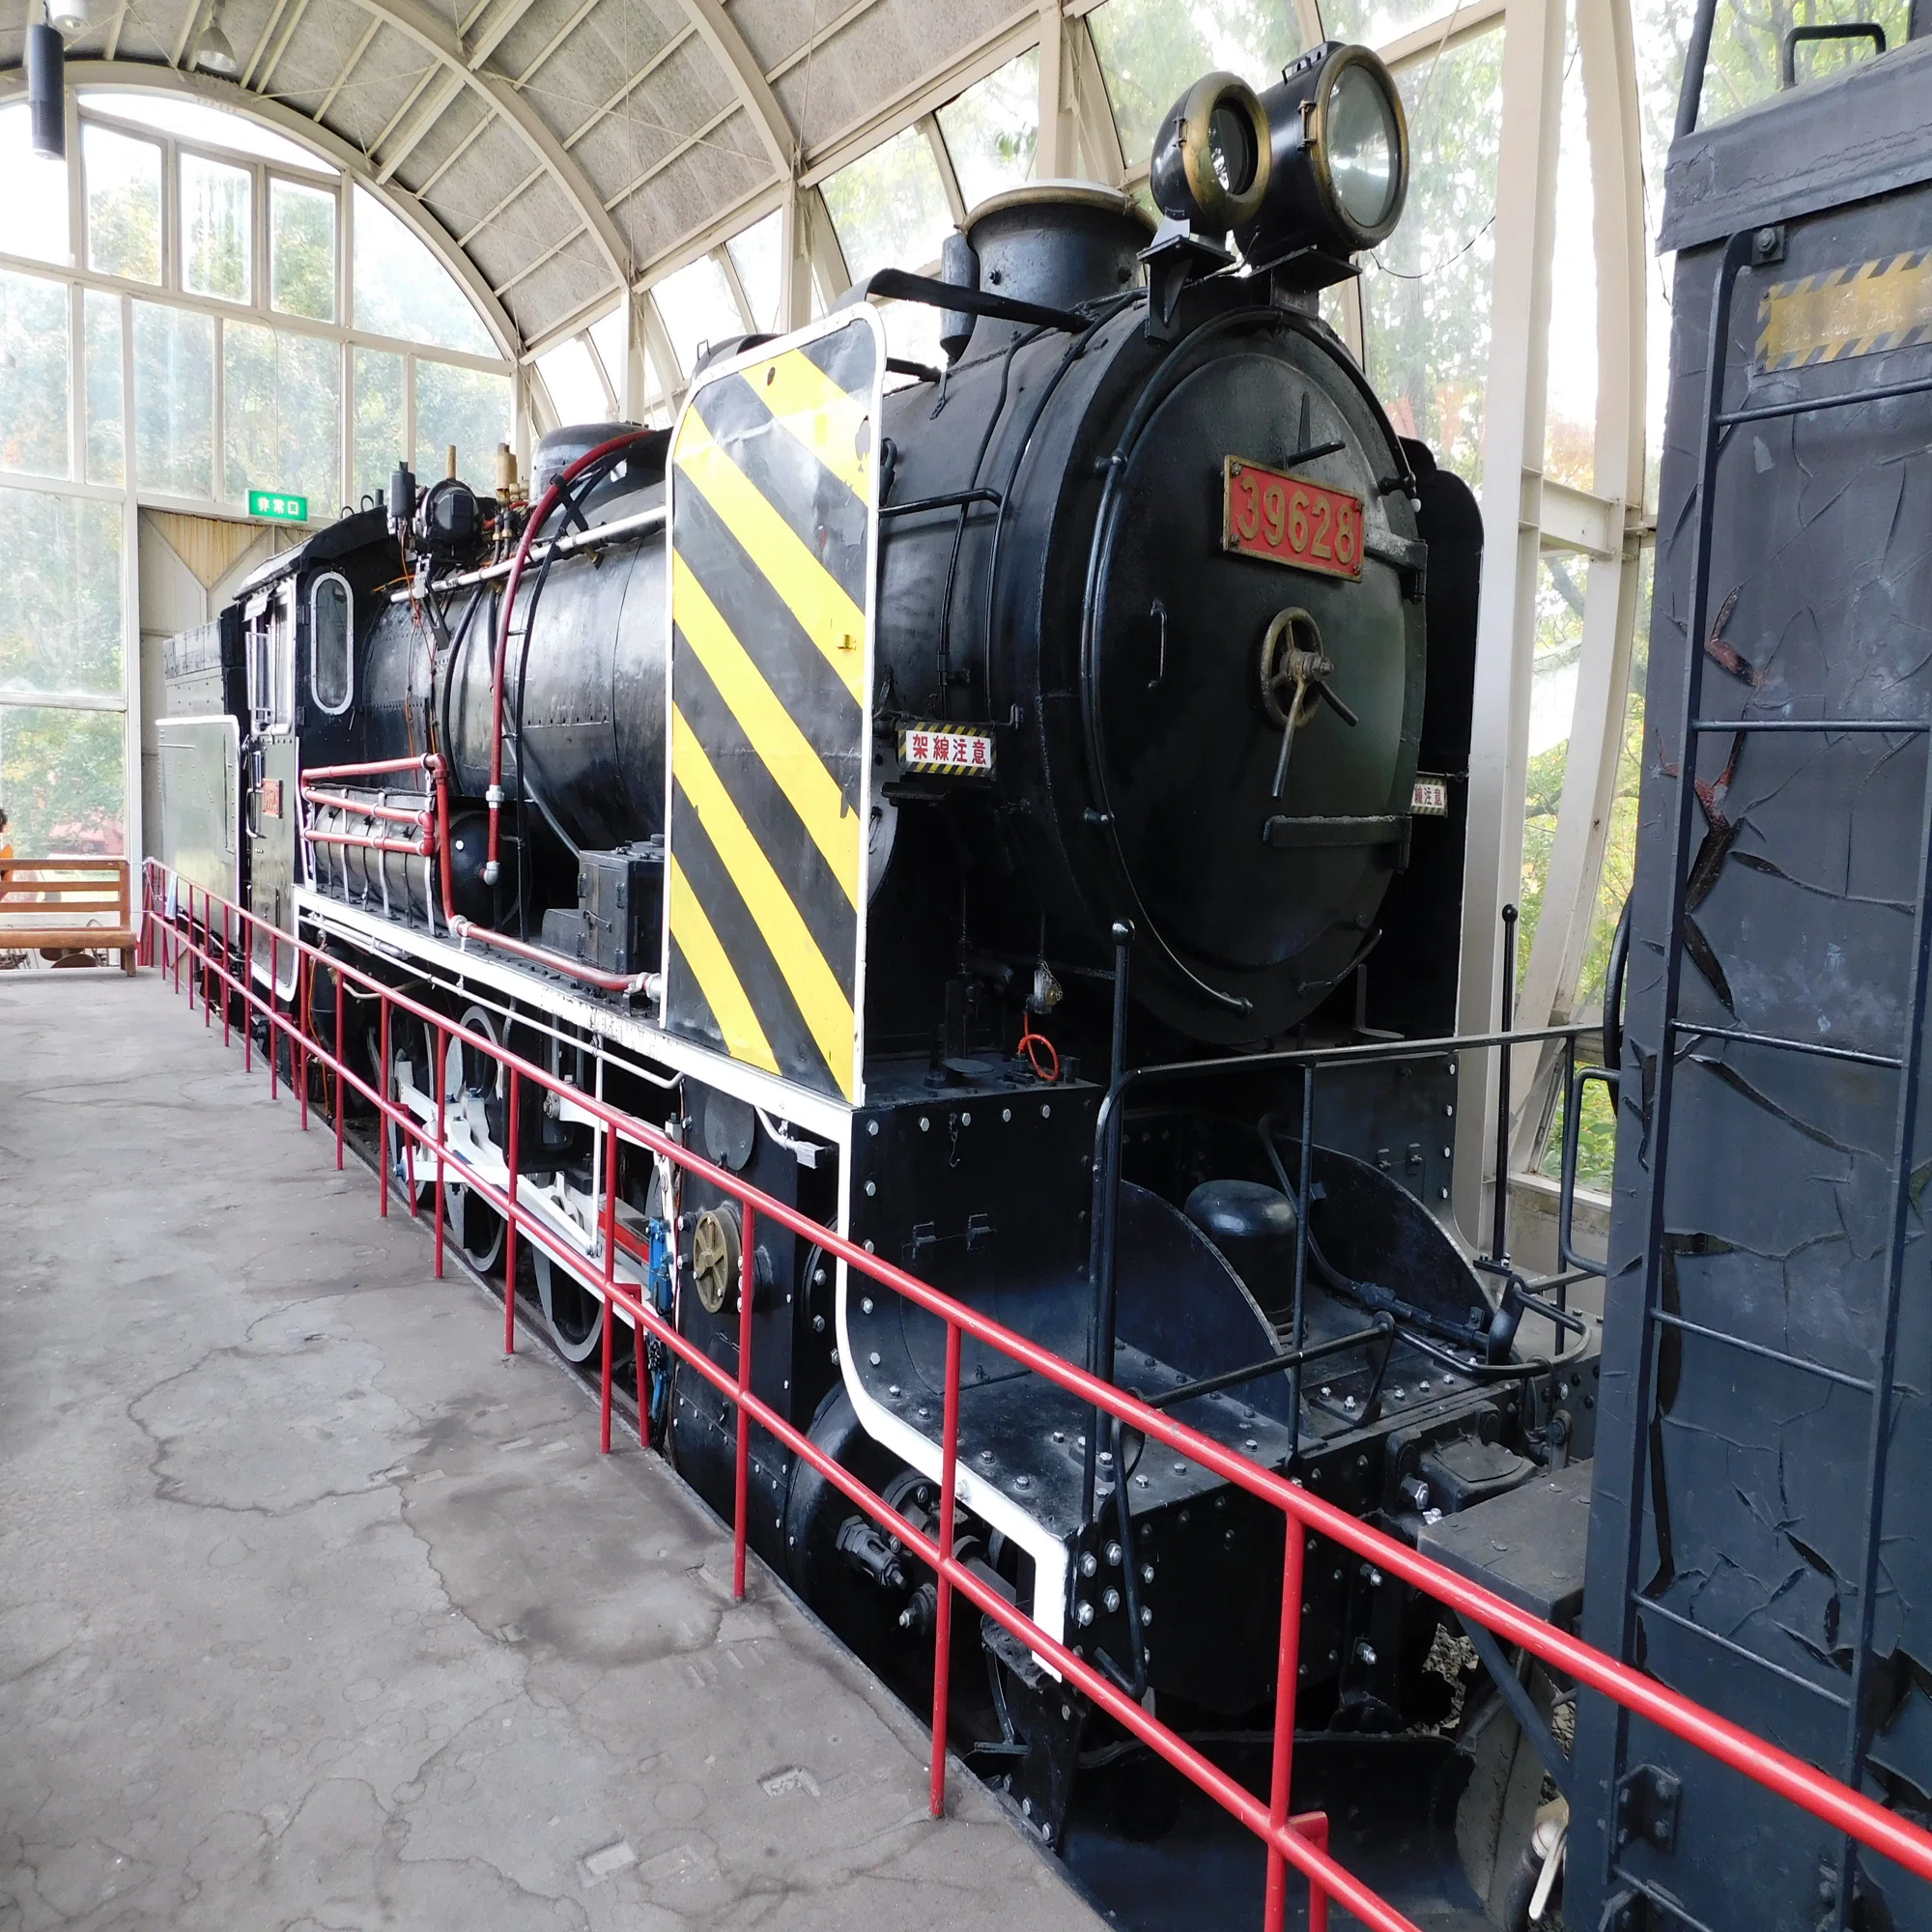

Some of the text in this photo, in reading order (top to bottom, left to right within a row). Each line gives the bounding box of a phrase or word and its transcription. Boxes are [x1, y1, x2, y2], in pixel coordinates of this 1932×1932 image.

[257, 497, 299, 516] 非常口
[1237, 475, 1354, 565] 39628
[912, 733, 987, 765] 架線注意
